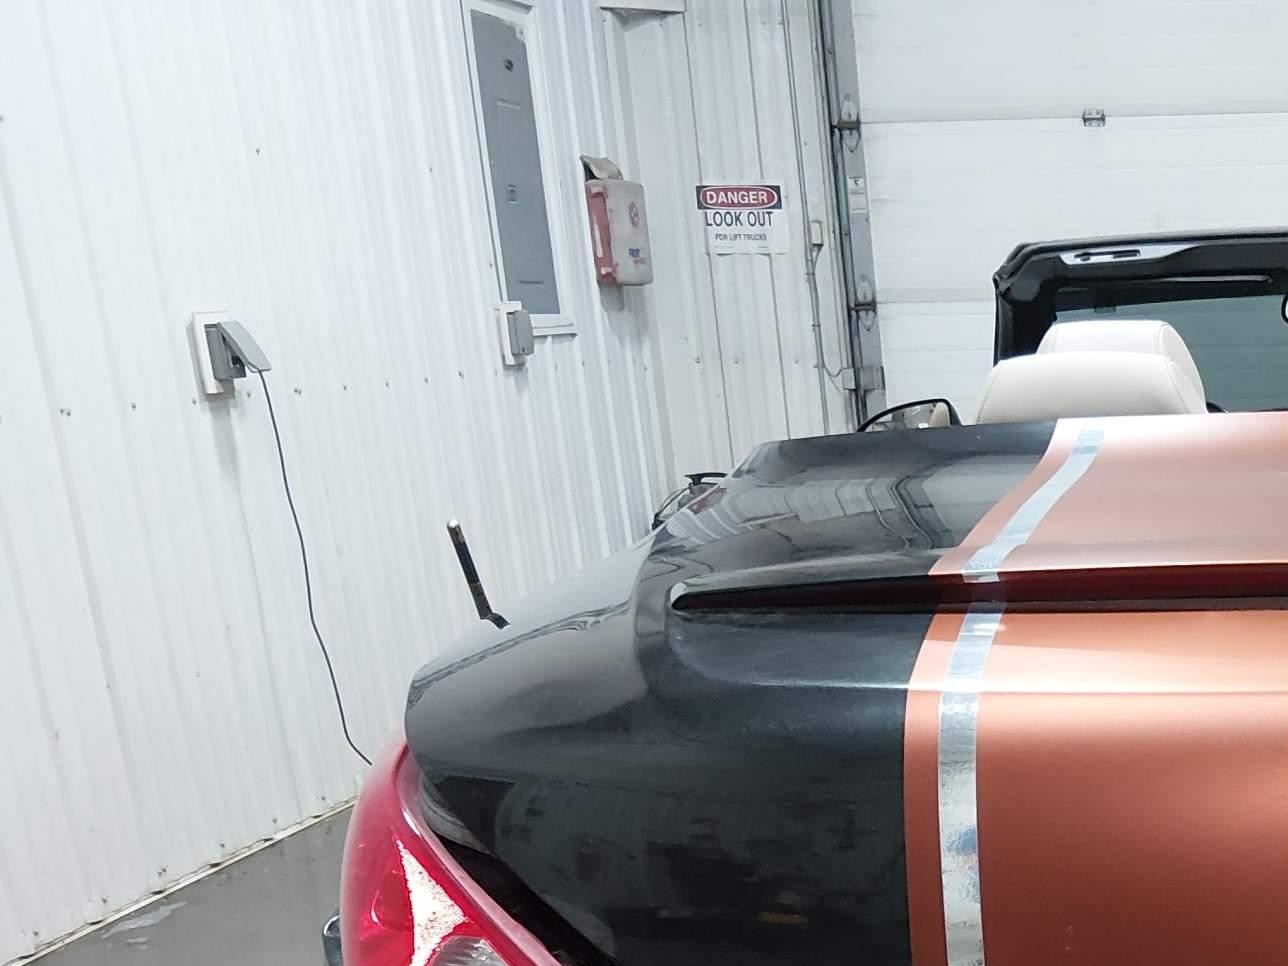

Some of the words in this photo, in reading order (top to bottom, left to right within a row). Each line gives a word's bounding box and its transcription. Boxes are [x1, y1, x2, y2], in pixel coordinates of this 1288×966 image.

[706, 191, 768, 204] DANGER
[705, 211, 743, 227] LOOK
[747, 211, 773, 227] OUT
